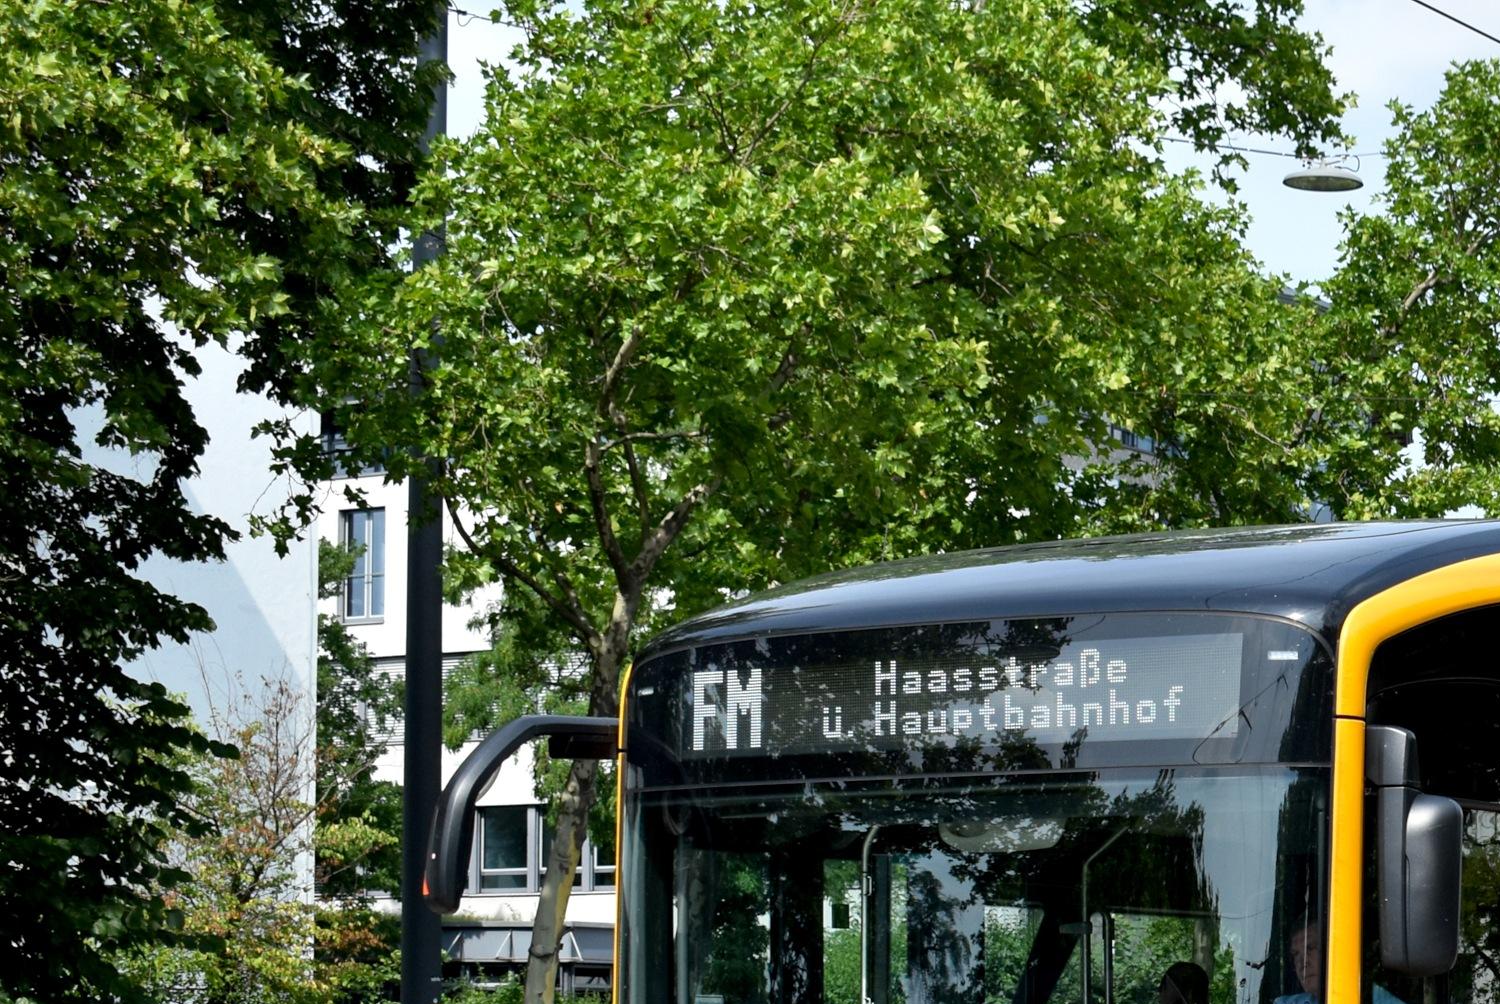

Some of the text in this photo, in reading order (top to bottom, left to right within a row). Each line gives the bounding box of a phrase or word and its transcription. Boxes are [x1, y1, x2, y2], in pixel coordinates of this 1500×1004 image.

[874, 648, 1127, 696] Haasstraße
[693, 668, 762, 750] FM
[823, 685, 1183, 738] ü. Hauptbahnhof
